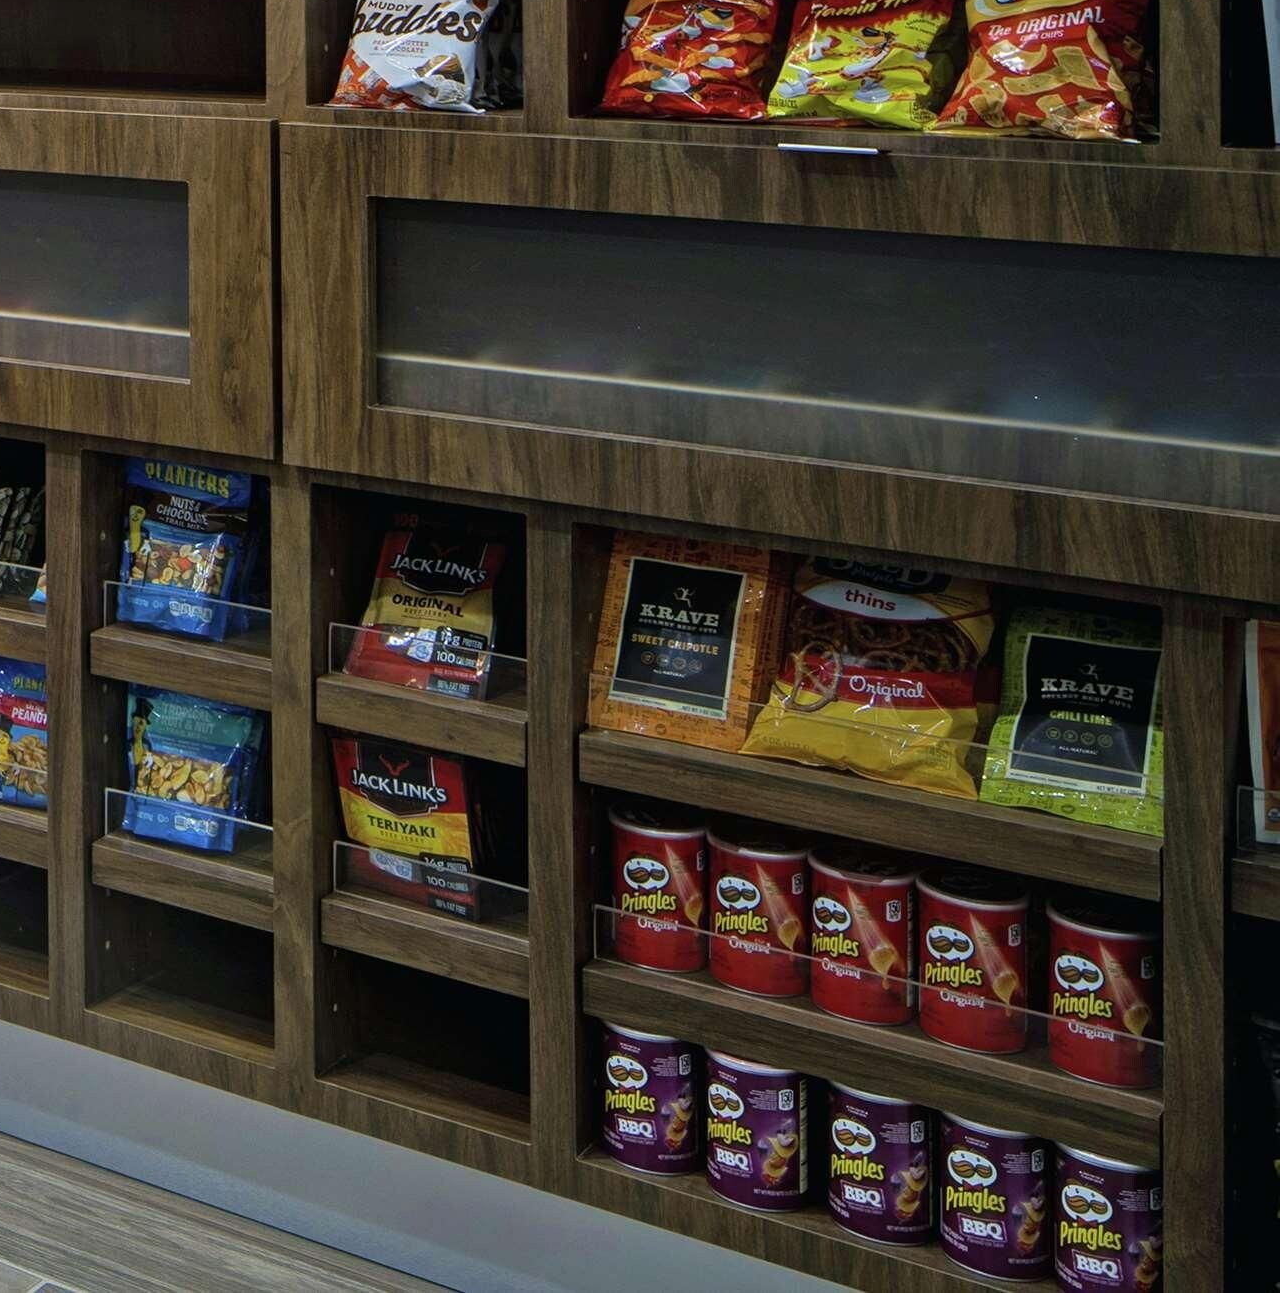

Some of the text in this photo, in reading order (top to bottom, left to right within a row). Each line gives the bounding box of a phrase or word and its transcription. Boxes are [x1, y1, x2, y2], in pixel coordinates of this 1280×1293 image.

[368, 0, 412, 13] MUDDY
[1015, 6, 1106, 35] ORIGINAL
[1040, 29, 1064, 41] CHIPS
[145, 462, 231, 500] PLANTERS
[170, 495, 195, 512] NUTS
[390, 554, 488, 584] JACK LINK'S
[392, 593, 464, 618] ORIGINAL
[844, 586, 897, 613] thins
[639, 604, 720, 628] KRAVE
[436, 650, 456, 663] 100
[631, 632, 720, 656] SWEET CHIPOTLE
[848, 674, 925, 704] Original
[1040, 677, 1134, 702] KRAVE
[1049, 709, 1113, 727] CHILI LIME
[352, 769, 447, 803] JACK LINK'S
[367, 814, 436, 839] TERIYAKI
[622, 892, 677, 916] Pringles
[715, 912, 769, 936] Pringles
[812, 933, 860, 959] Pringles
[925, 962, 984, 987] Pringles
[1052, 992, 1113, 1020] Pringles
[605, 1089, 655, 1114] Pringles
[617, 1117, 655, 1139] BBQ
[706, 1117, 753, 1146] Pringles
[714, 1149, 750, 1173] BBQ
[830, 1153, 885, 1182] Pringles
[843, 1185, 883, 1207] BBQ
[945, 1185, 1006, 1214] Pringles
[961, 1217, 1005, 1240] BBQ
[1059, 1221, 1123, 1252] Pringles
[1075, 1253, 1120, 1278] BBQ
